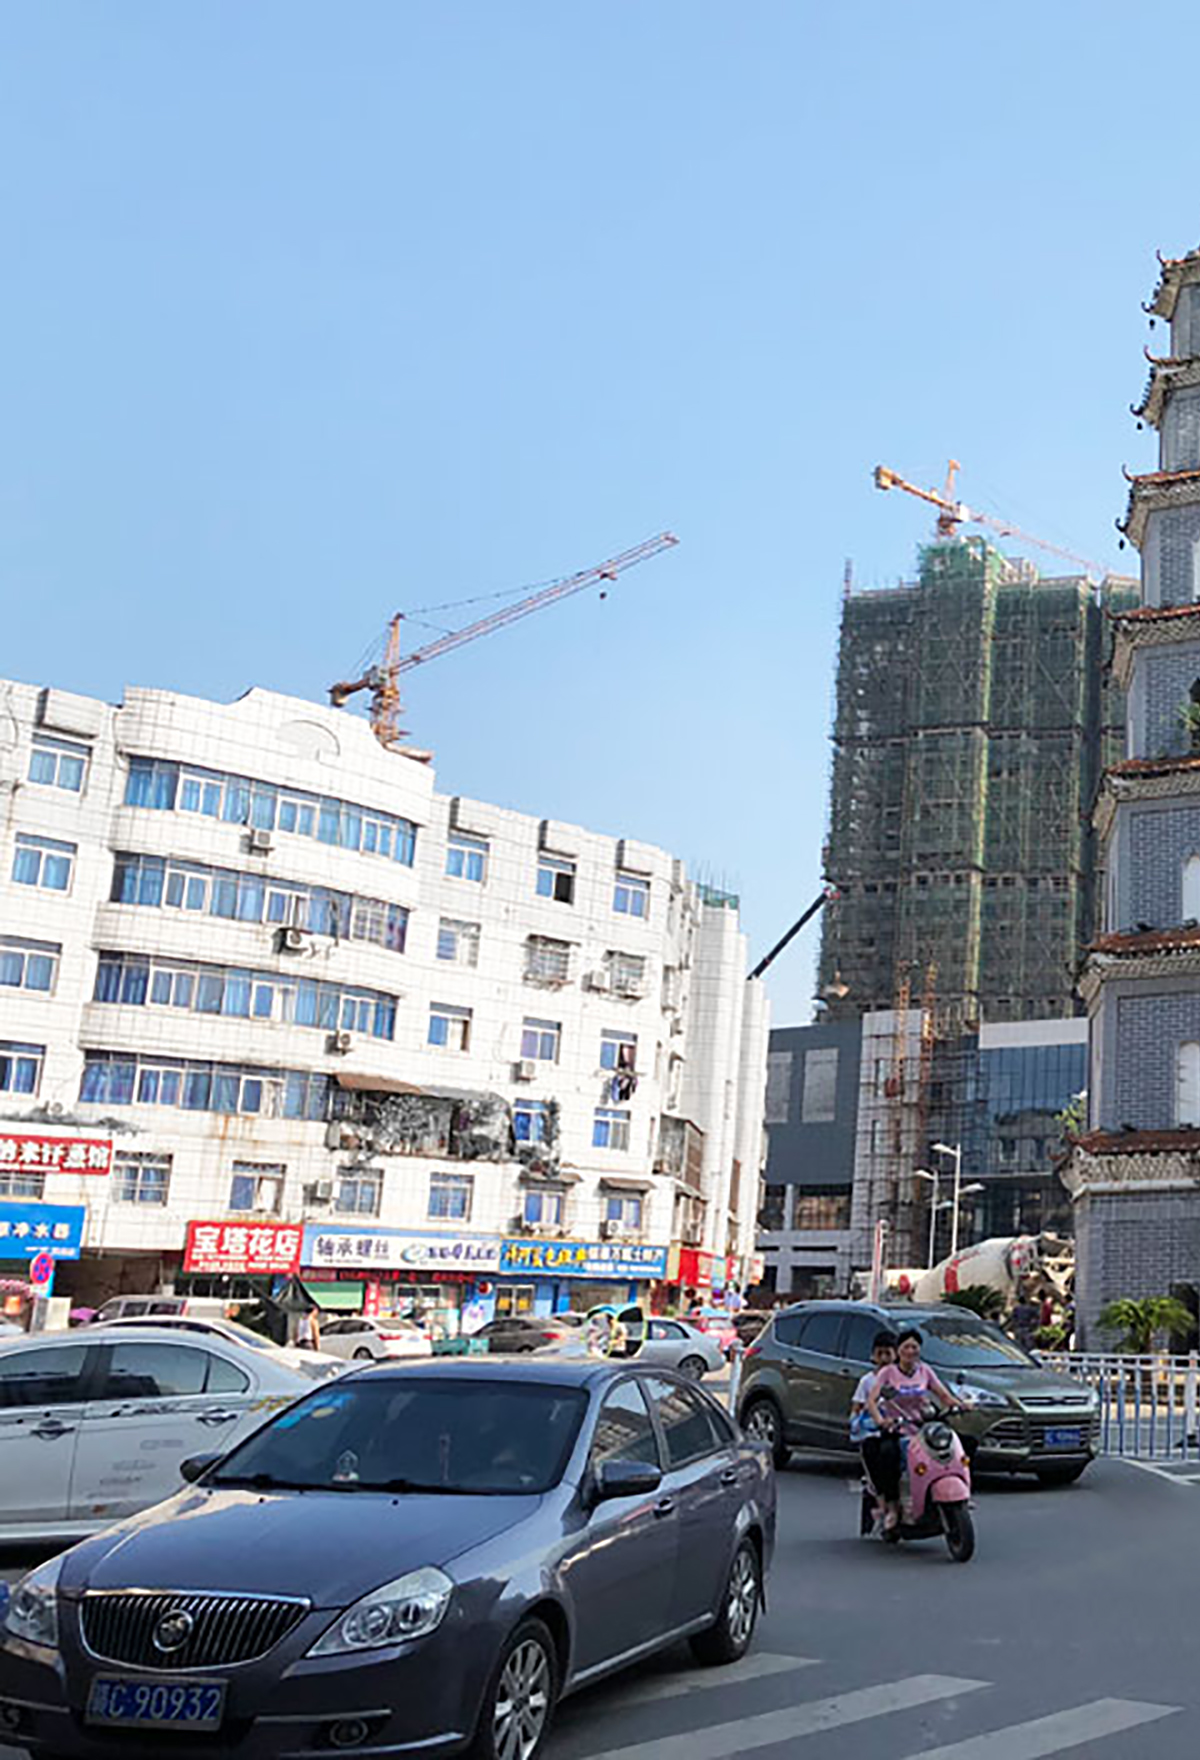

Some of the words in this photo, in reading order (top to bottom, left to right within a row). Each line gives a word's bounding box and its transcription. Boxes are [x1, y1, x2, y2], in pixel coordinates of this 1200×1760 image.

[191, 1226, 300, 1255] 宝塔花店
[317, 1236, 390, 1258] 轴承螺丝
